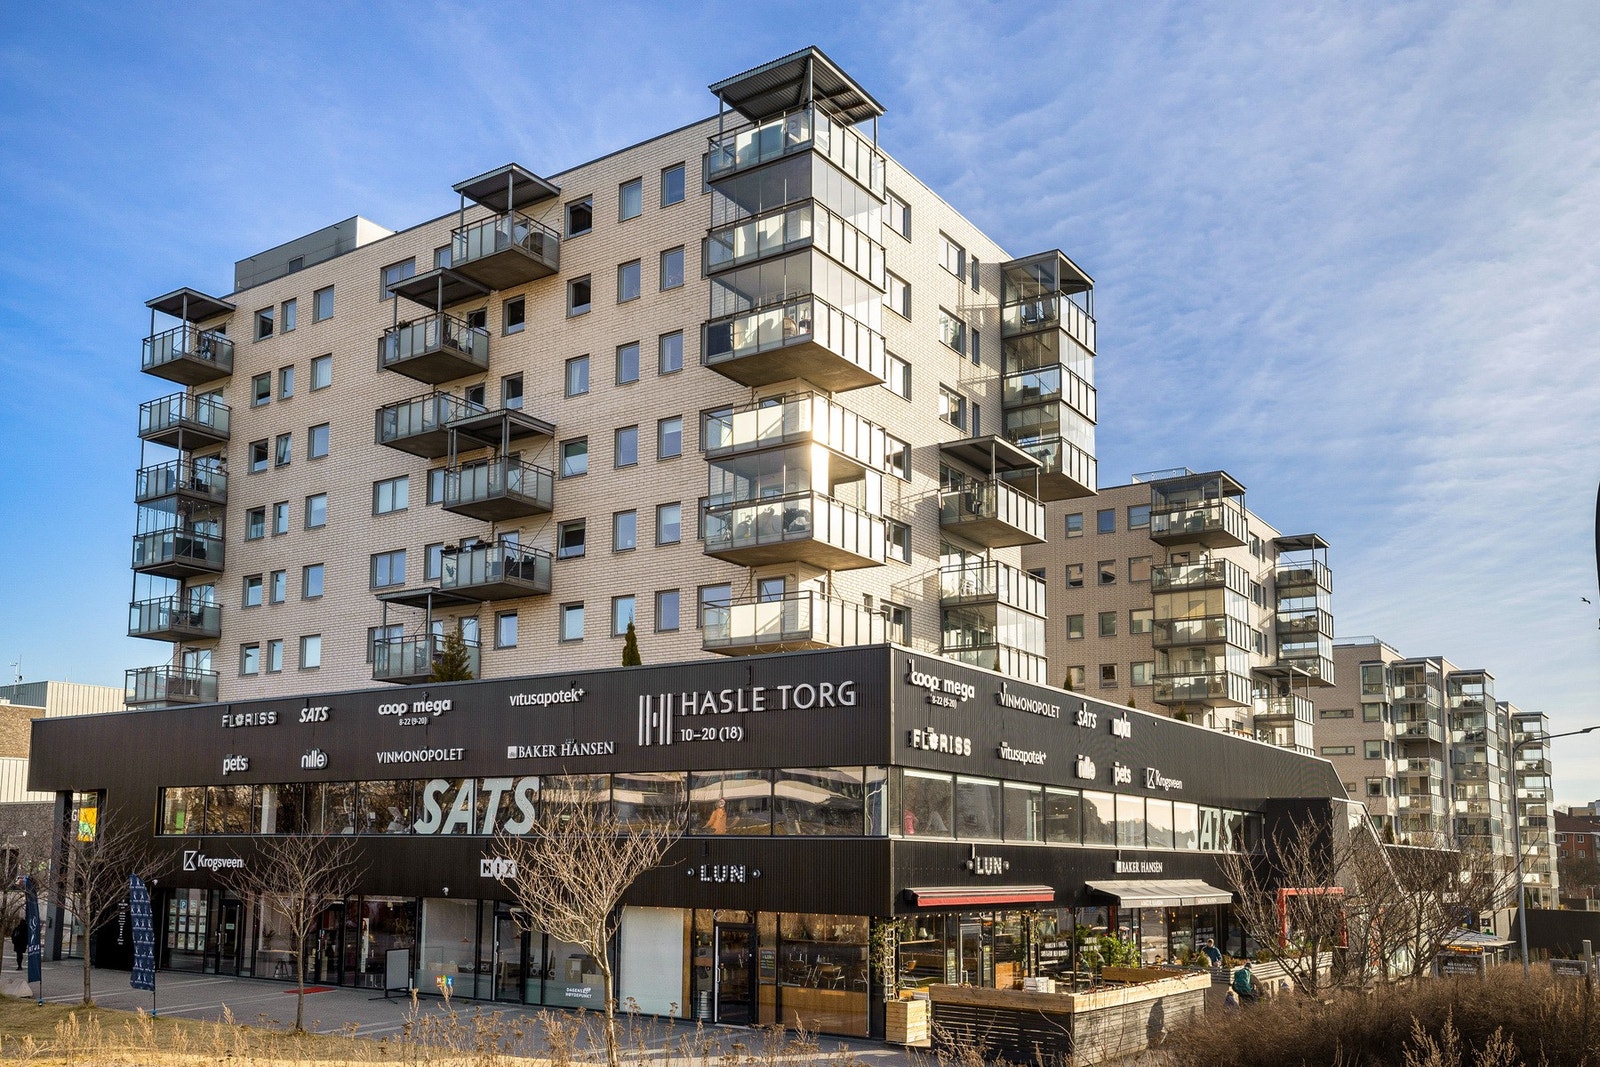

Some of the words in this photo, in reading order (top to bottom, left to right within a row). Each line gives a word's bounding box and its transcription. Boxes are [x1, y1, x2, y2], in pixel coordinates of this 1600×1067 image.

[911, 671, 939, 692] coop
[943, 679, 975, 702] mega
[378, 701, 408, 716] coop
[412, 699, 452, 717] mega
[681, 686, 766, 716] HASLE
[777, 680, 858, 711] TORG
[1000, 691, 1060, 719] VINMONOPOLET
[221, 711, 278, 728] FLORISS
[299, 706, 330, 723] SATS
[1077, 709, 1097, 729] SATS
[719, 726, 744, 743] (18)
[913, 728, 971, 757] FLORISS
[301, 748, 328, 770] nille
[376, 748, 464, 764] VINMONOPOLET
[518, 744, 557, 759] BAKER
[560, 741, 615, 757] HANSEN
[222, 756, 249, 775] pets
[1078, 756, 1096, 780] nille
[1114, 765, 1132, 786] pets
[1155, 770, 1183, 791] Krogsveen
[413, 778, 540, 835] SATS
[1187, 811, 1235, 851] SATS
[197, 854, 243, 872] Krogsveen
[481, 856, 517, 880] MIX
[975, 857, 1003, 875] LUN
[1121, 861, 1140, 873] BAKER
[1140, 861, 1163, 873] HANSEN
[700, 864, 746, 883] LUN
